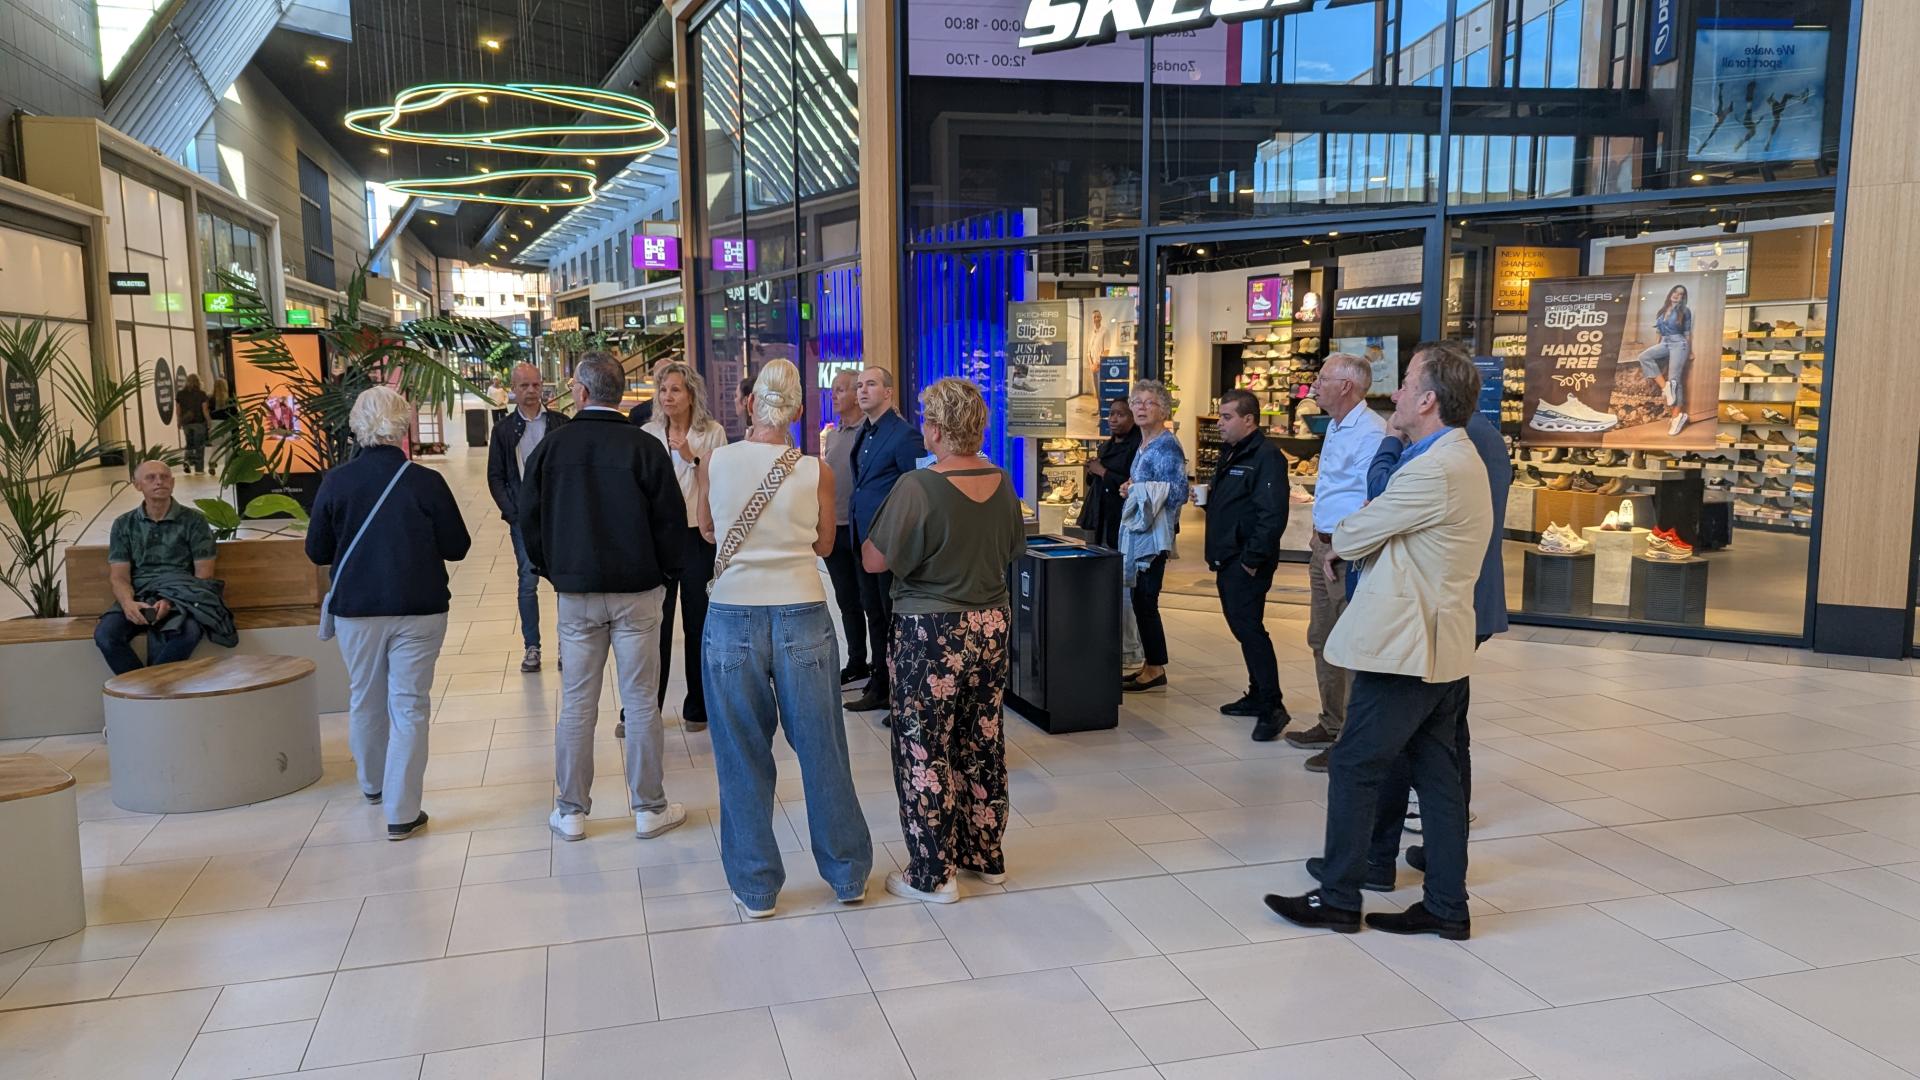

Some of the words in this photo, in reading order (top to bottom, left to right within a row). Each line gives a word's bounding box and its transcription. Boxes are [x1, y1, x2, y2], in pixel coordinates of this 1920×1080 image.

[1336, 291, 1422, 311] SKECHERS
[1544, 293, 1613, 303] SKECHERS
[1545, 310, 1608, 330] Slip-ins
[1016, 323, 1057, 340] Slip-ins
[1576, 330, 1604, 343] GO
[1014, 343, 1039, 354] JUST
[1541, 343, 1603, 356] HANDS
[1014, 354, 1039, 365] STEP
[1038, 352, 1051, 365] IN
[1555, 356, 1600, 369] FREE
